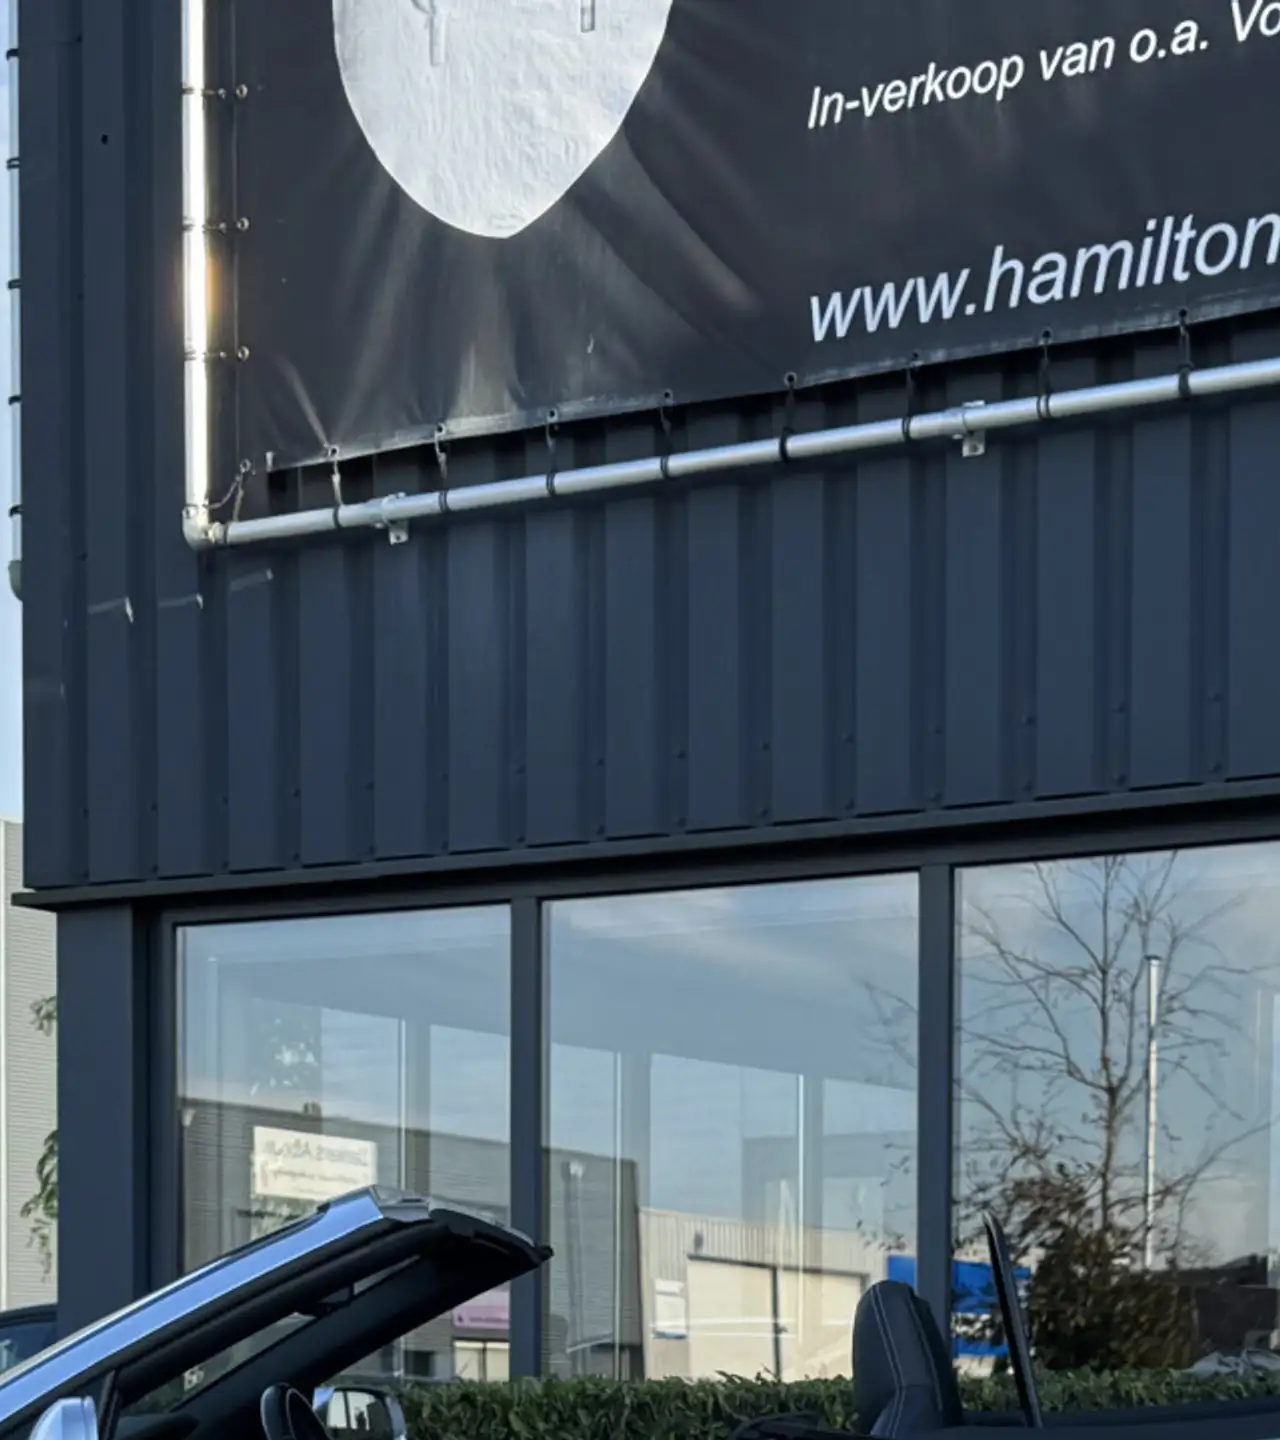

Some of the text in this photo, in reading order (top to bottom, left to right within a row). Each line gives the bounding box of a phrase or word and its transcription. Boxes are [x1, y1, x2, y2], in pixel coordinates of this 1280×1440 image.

[807, 54, 1025, 130] In-verkoop
[1039, 36, 1116, 82] van
[1128, 19, 1209, 64] o.a.
